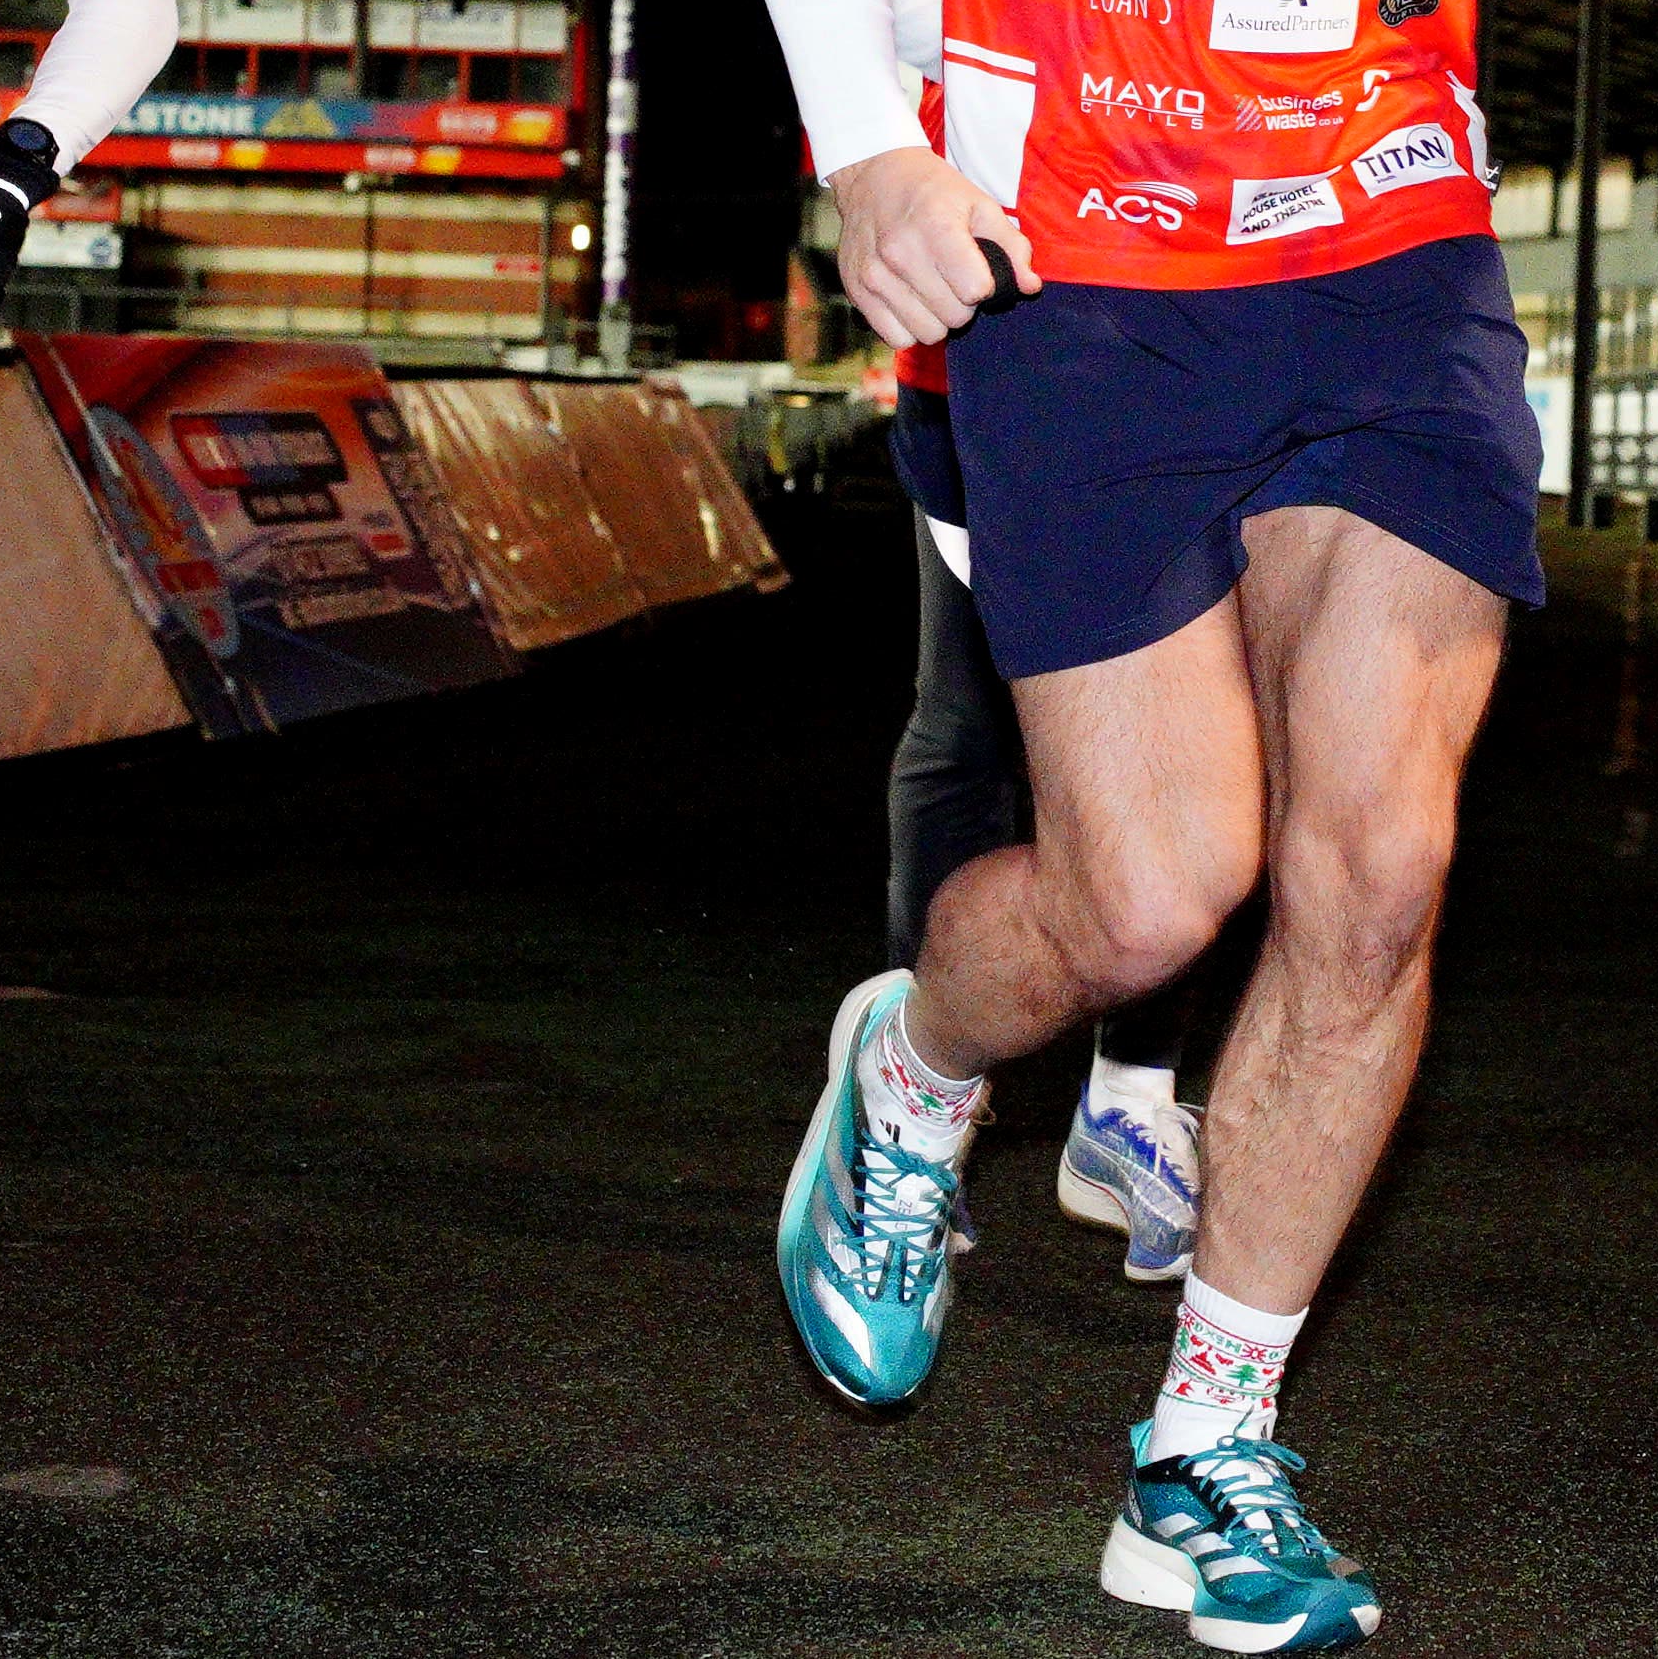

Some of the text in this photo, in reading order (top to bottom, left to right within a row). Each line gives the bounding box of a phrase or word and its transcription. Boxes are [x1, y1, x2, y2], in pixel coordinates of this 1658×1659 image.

[1221, 12, 1350, 32] AssuredPartners
[1081, 73, 1205, 115] MAYO
[1257, 90, 1344, 111] business
[1081, 101, 1205, 131] CIVILS
[1265, 110, 1316, 130] waste
[1357, 136, 1446, 177] TITAN
[1077, 188, 1183, 231] ACS
[1243, 199, 1277, 222] HOUSE
[1280, 184, 1317, 205] HOTEL
[1241, 218, 1271, 233] AND
